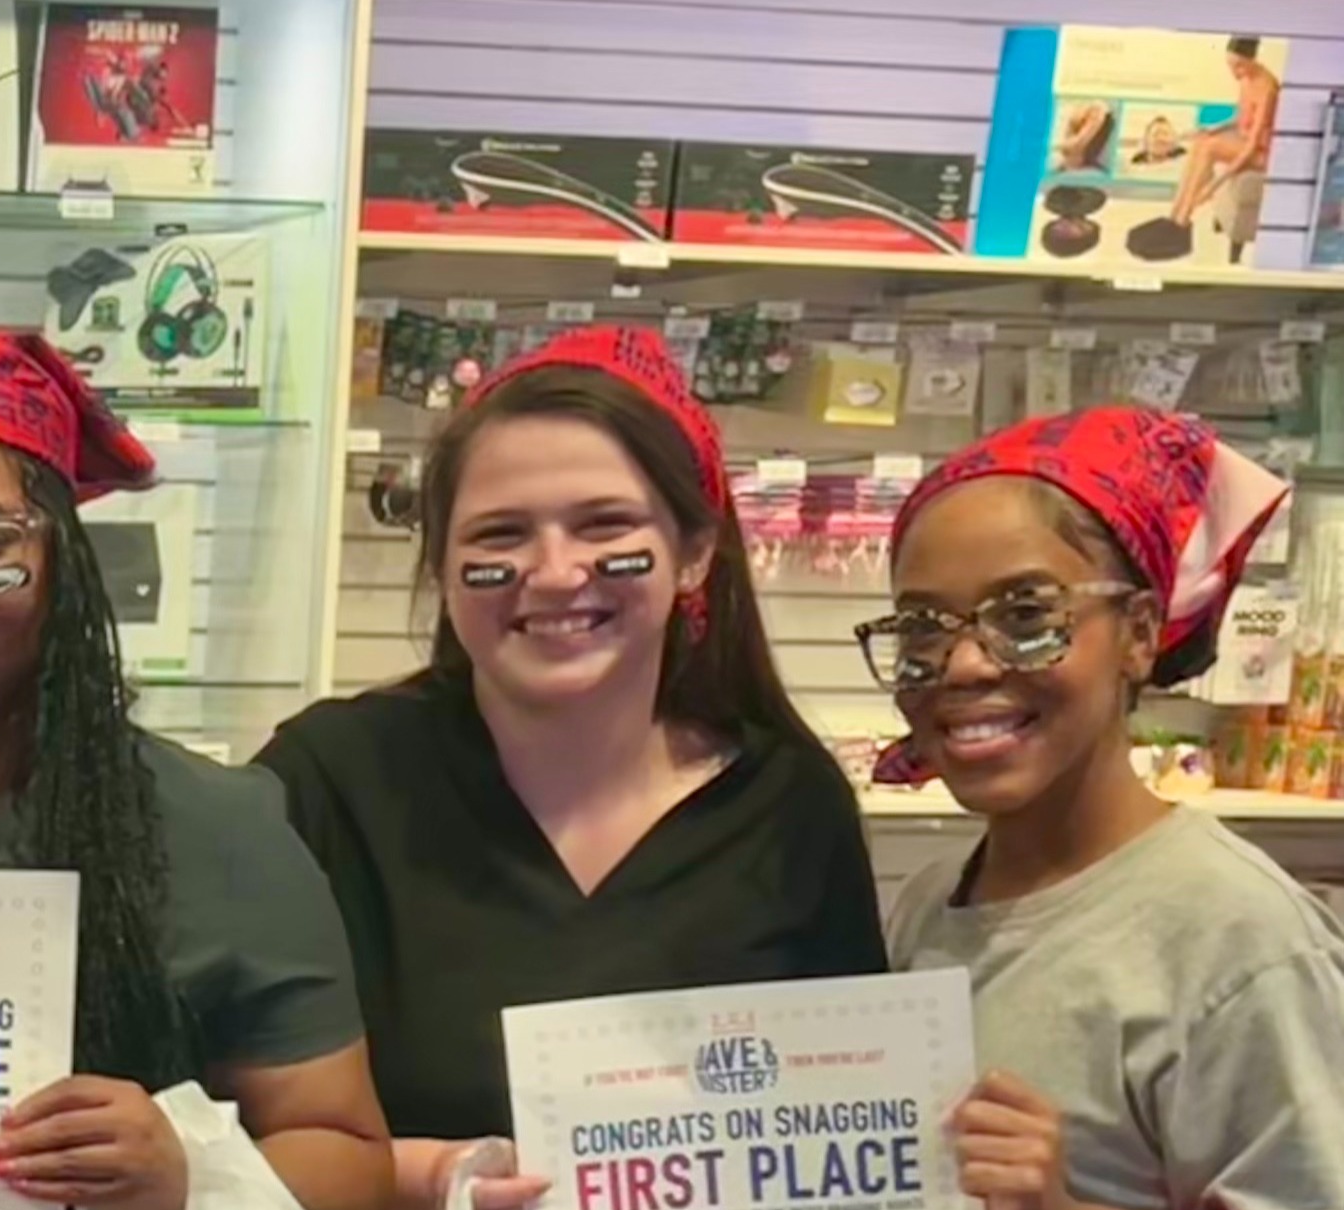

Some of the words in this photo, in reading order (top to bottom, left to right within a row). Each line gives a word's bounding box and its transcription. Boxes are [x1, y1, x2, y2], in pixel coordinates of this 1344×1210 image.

[1233, 610, 1286, 622] MOOD
[571, 1114, 715, 1152] CONGRATS
[726, 1110, 762, 1141] ON
[774, 1097, 916, 1137] SNAGGING
[748, 1136, 921, 1203] PLACE
